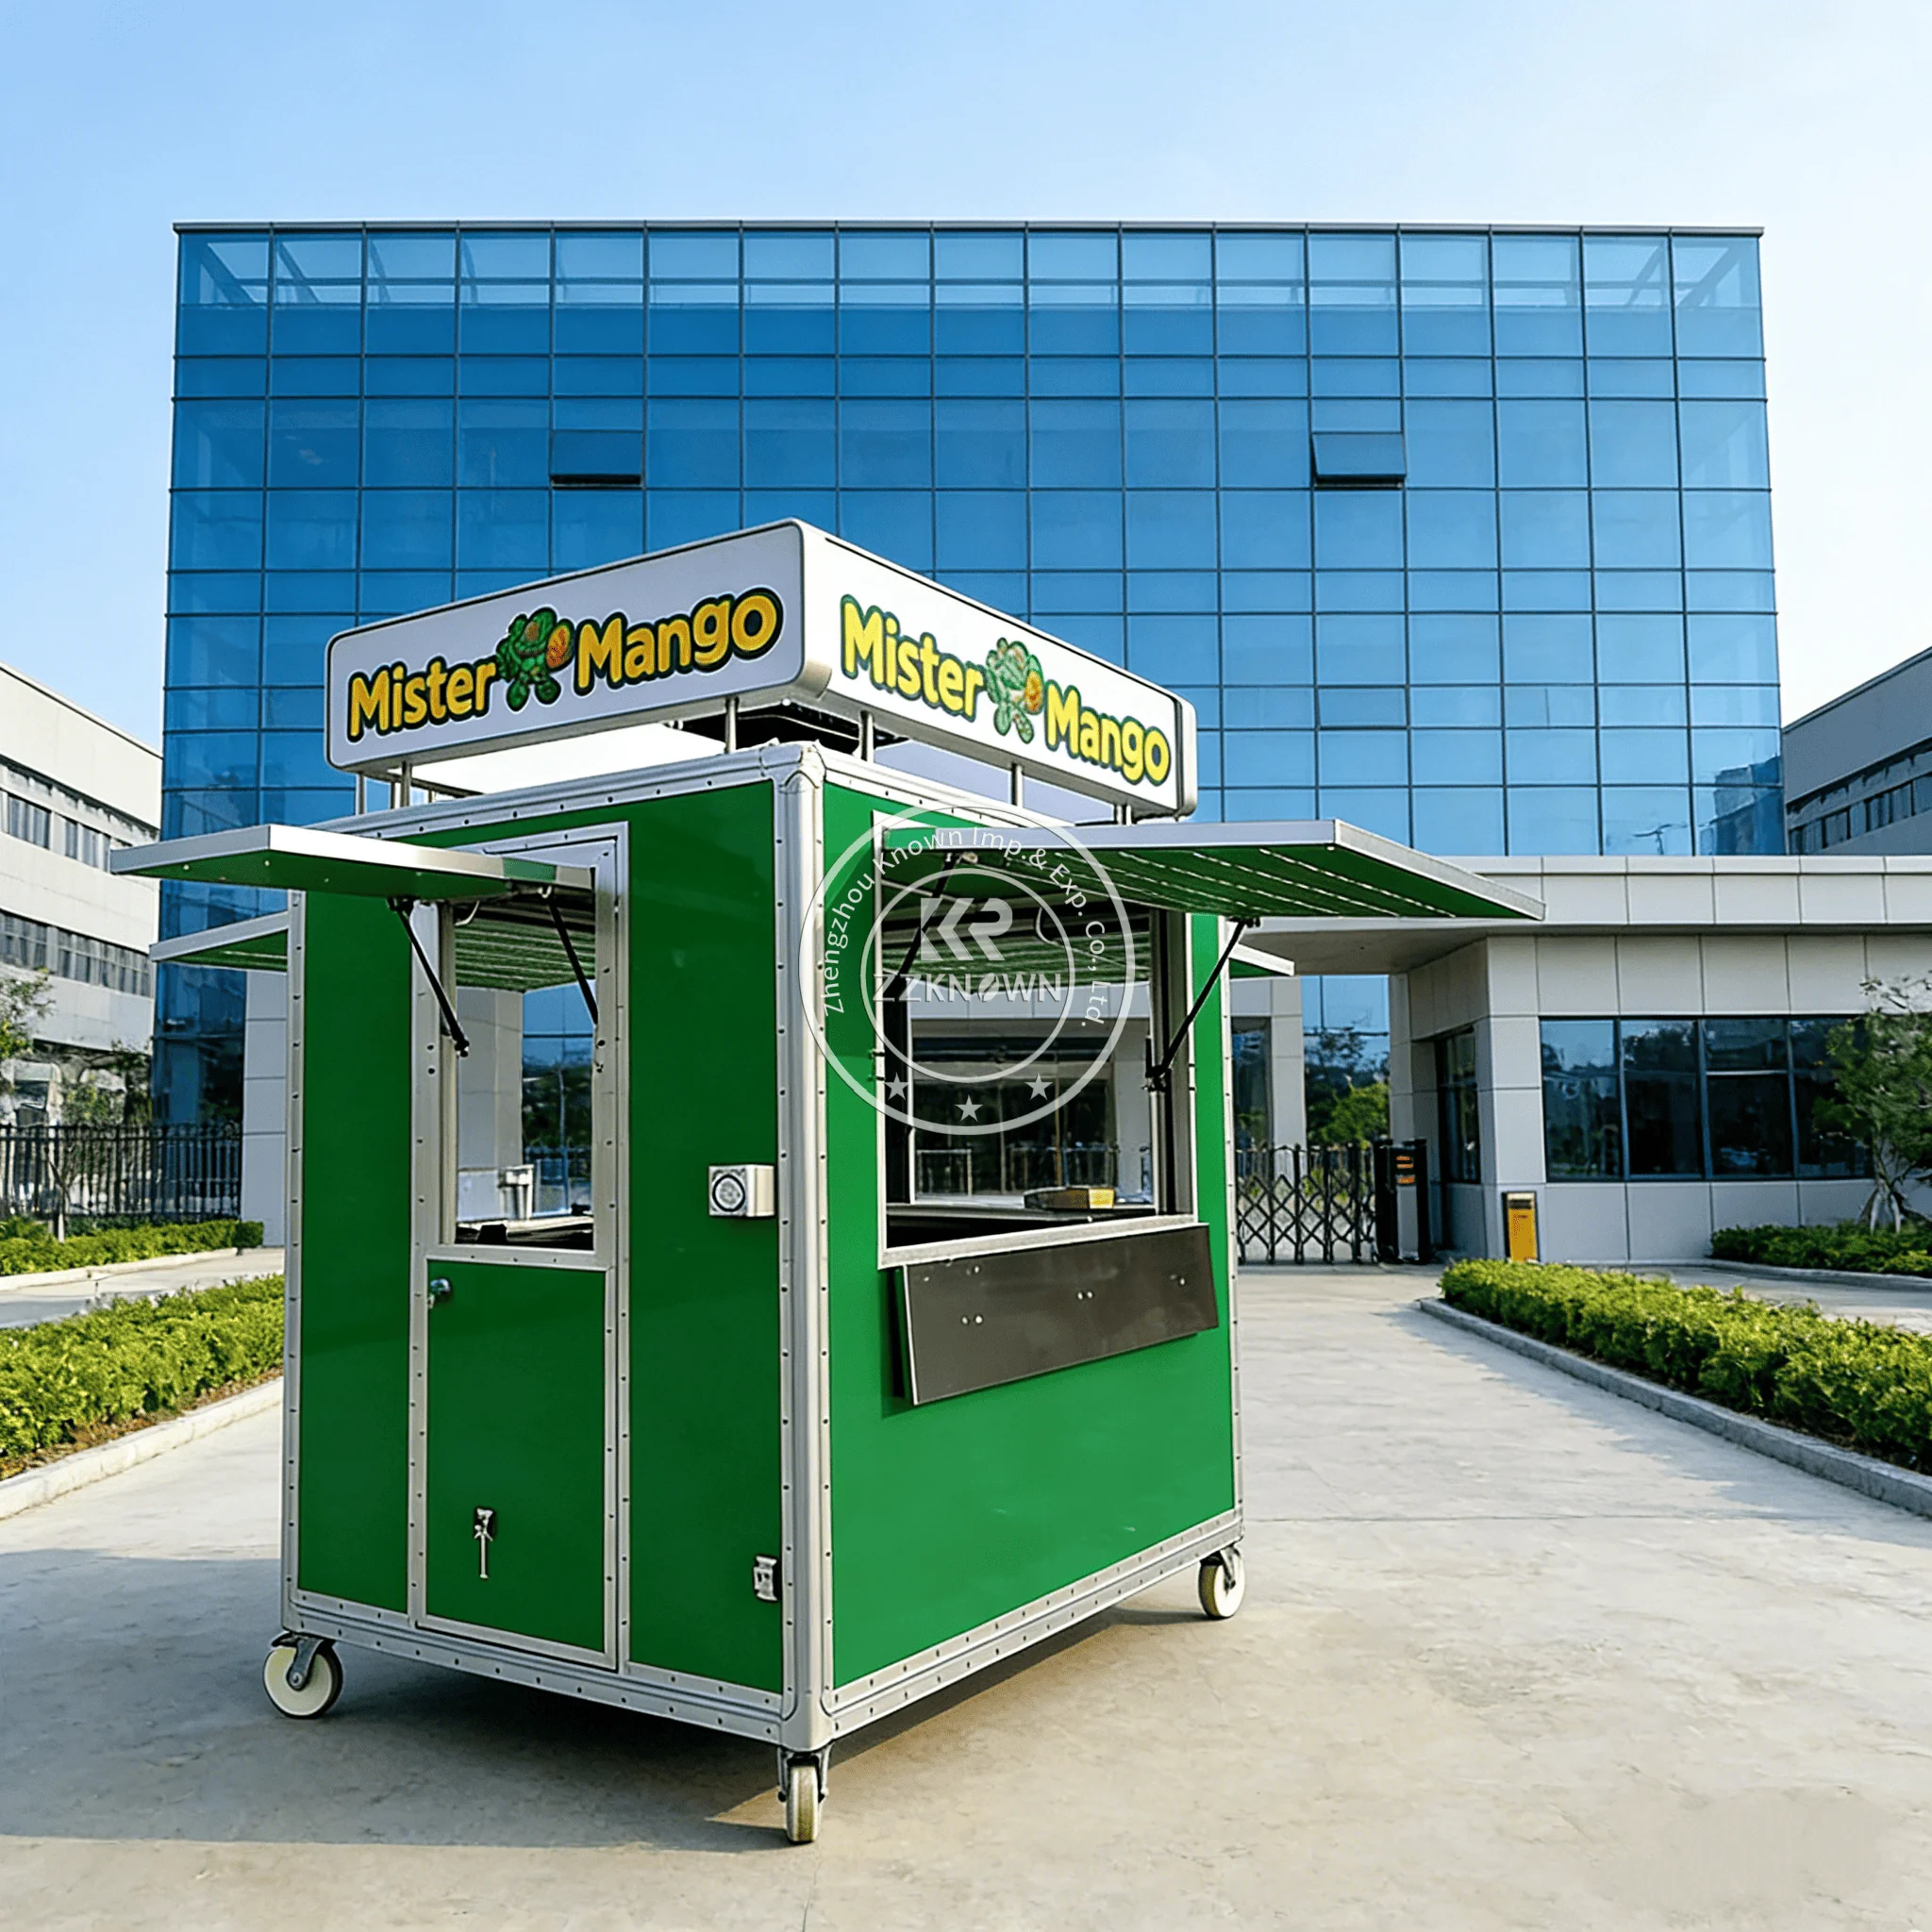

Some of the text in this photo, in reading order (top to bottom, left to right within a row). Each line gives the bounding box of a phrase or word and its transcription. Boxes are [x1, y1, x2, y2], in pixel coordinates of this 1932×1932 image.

[347, 588, 784, 741] Mister Mango
[840, 594, 1171, 786] Mister Mango
